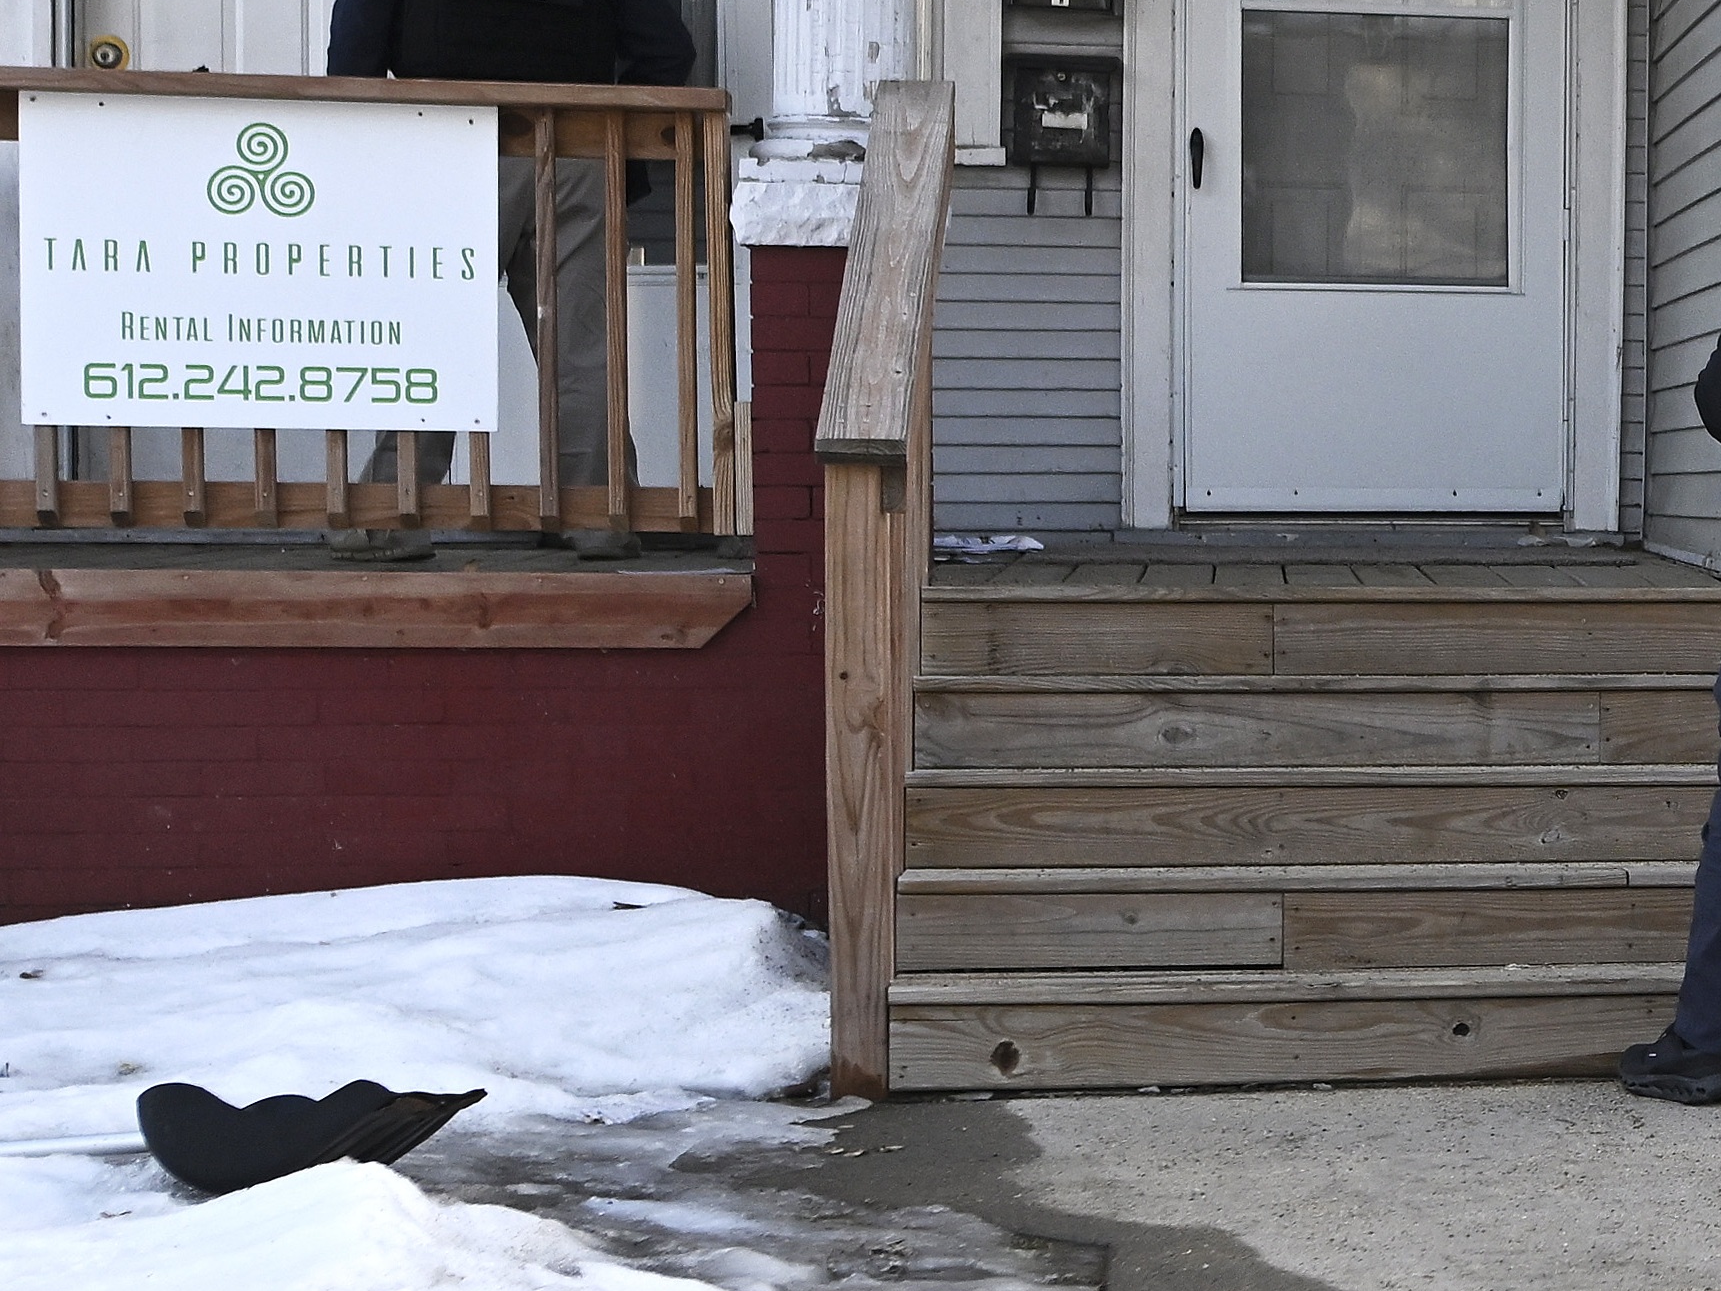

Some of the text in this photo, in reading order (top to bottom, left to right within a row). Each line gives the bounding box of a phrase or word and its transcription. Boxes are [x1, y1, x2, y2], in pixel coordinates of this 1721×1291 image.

[44, 237, 476, 281] TARA PROPERTIES
[83, 362, 439, 405] 612.242.8758
